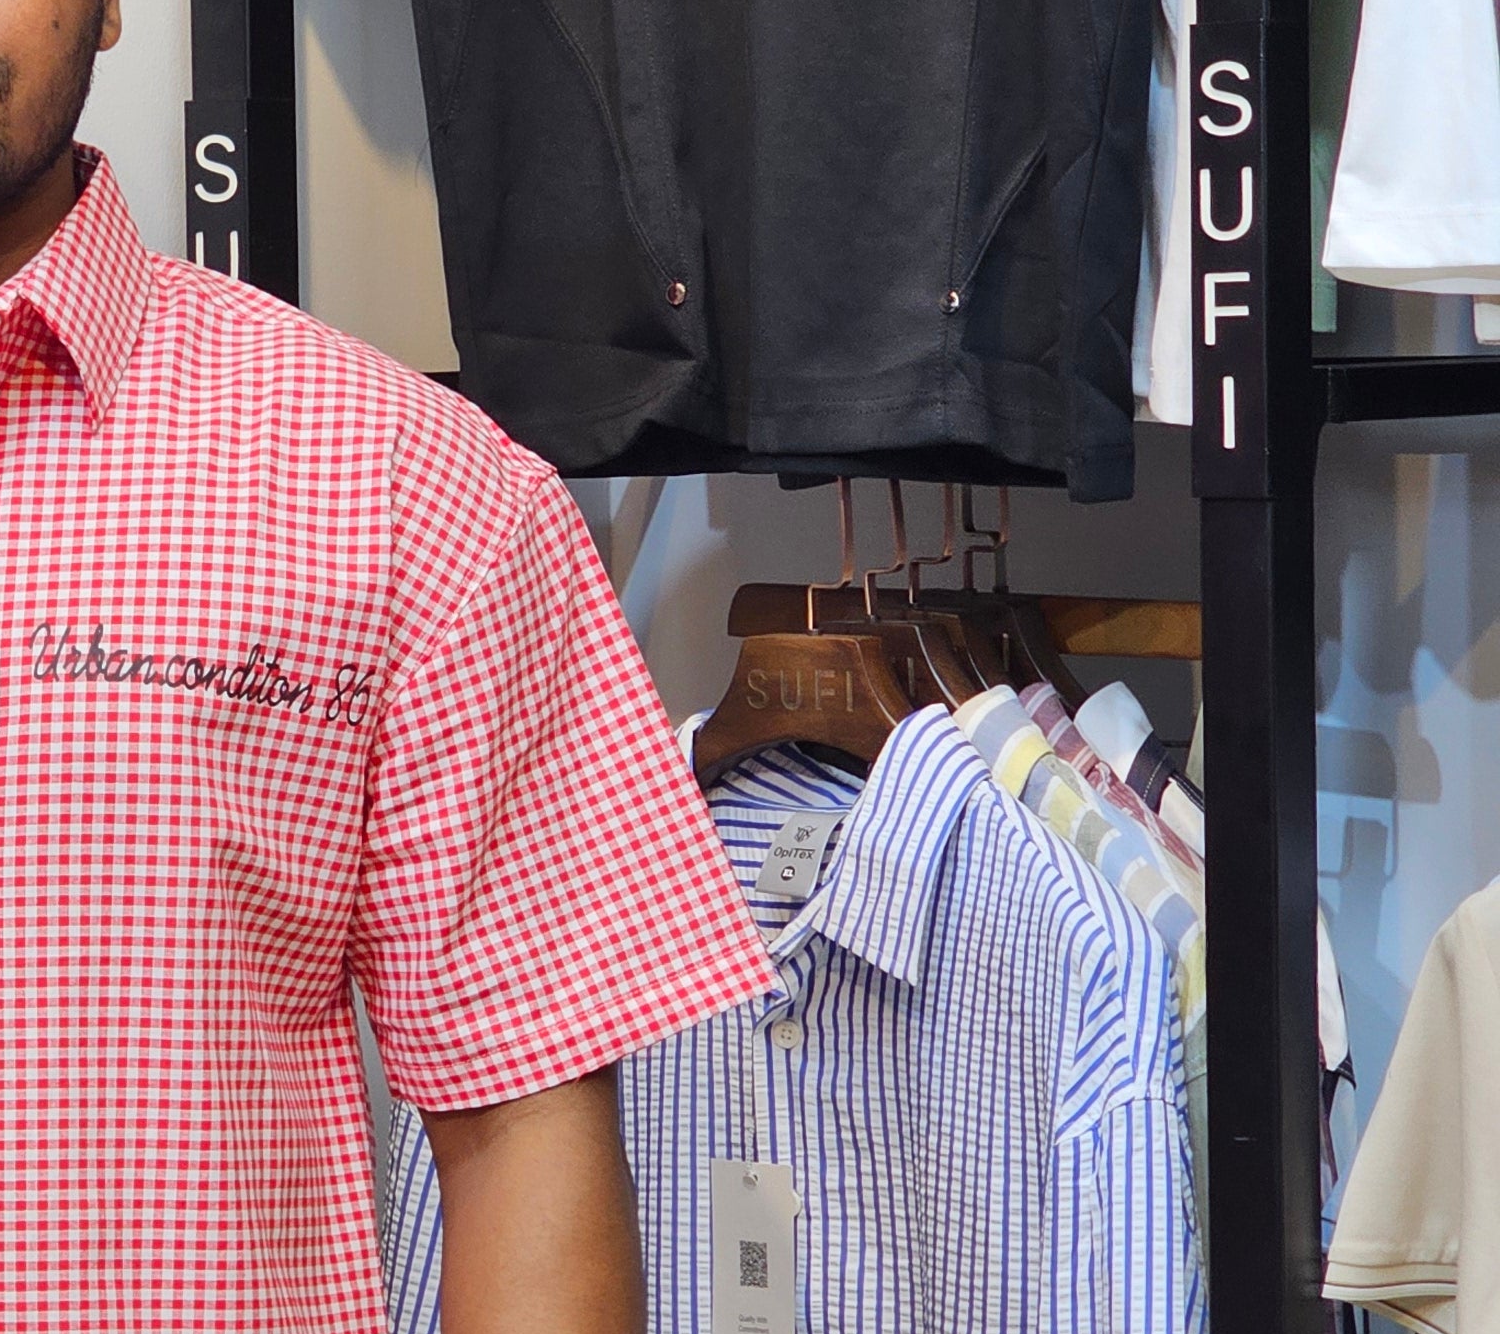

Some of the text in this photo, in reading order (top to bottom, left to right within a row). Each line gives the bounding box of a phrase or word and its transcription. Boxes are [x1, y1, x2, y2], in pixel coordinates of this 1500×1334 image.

[1198, 60, 1254, 450] SUFI
[325, 663, 377, 727] 86
[746, 668, 855, 712] SUFI
